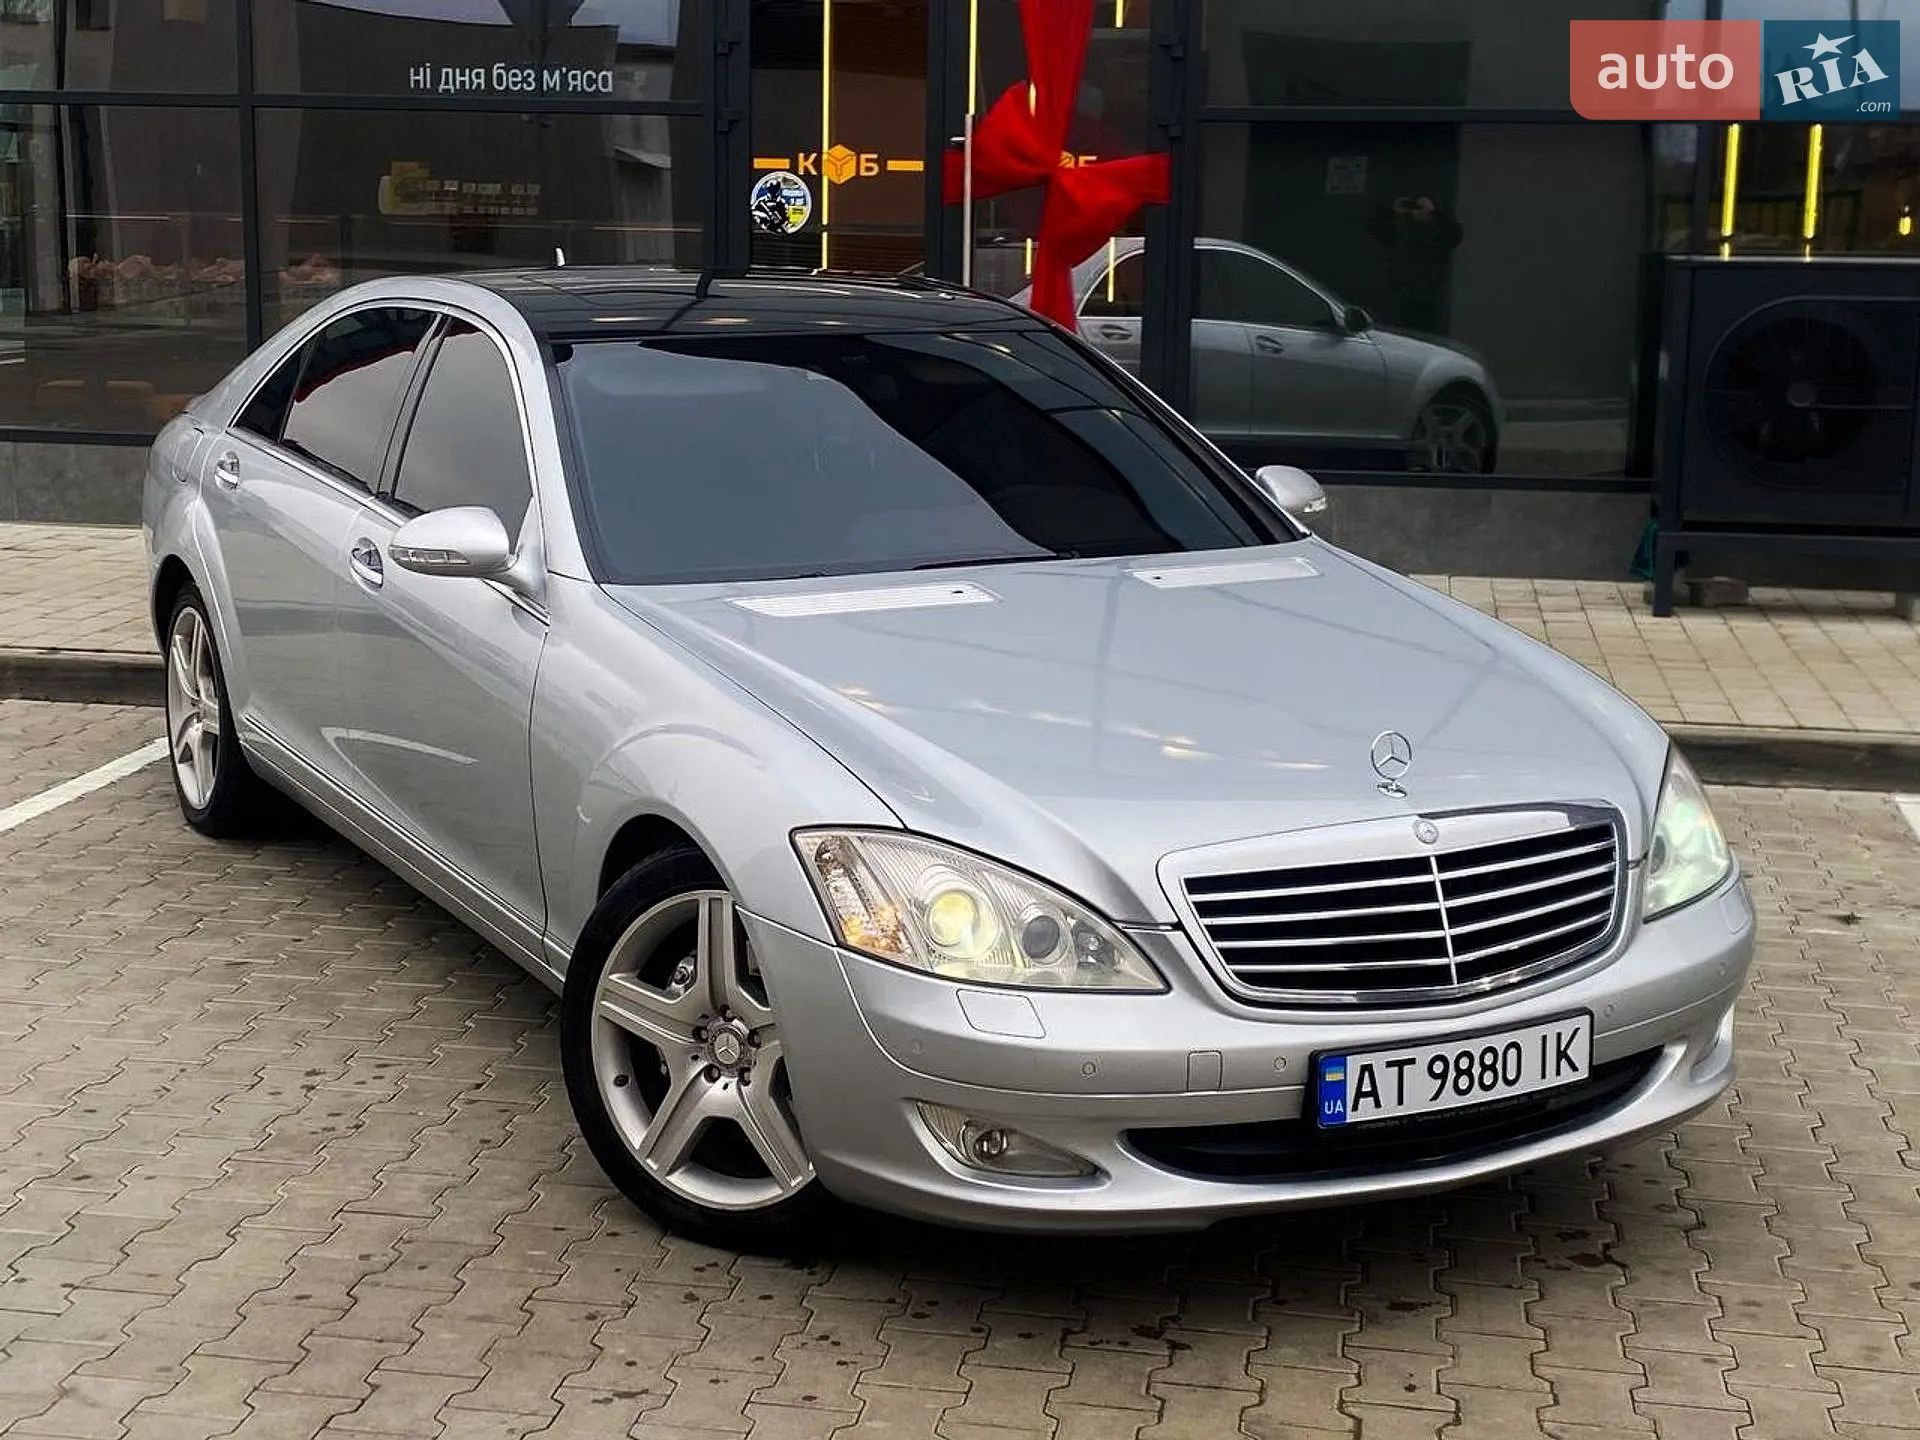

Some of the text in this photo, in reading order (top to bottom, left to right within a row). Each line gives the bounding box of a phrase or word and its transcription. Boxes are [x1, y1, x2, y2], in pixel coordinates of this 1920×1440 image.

[409, 62, 614, 94] ні дня без м'яса
[1351, 1026, 1581, 1112] AT 9880 IK
[1324, 1099, 1345, 1114] UA
